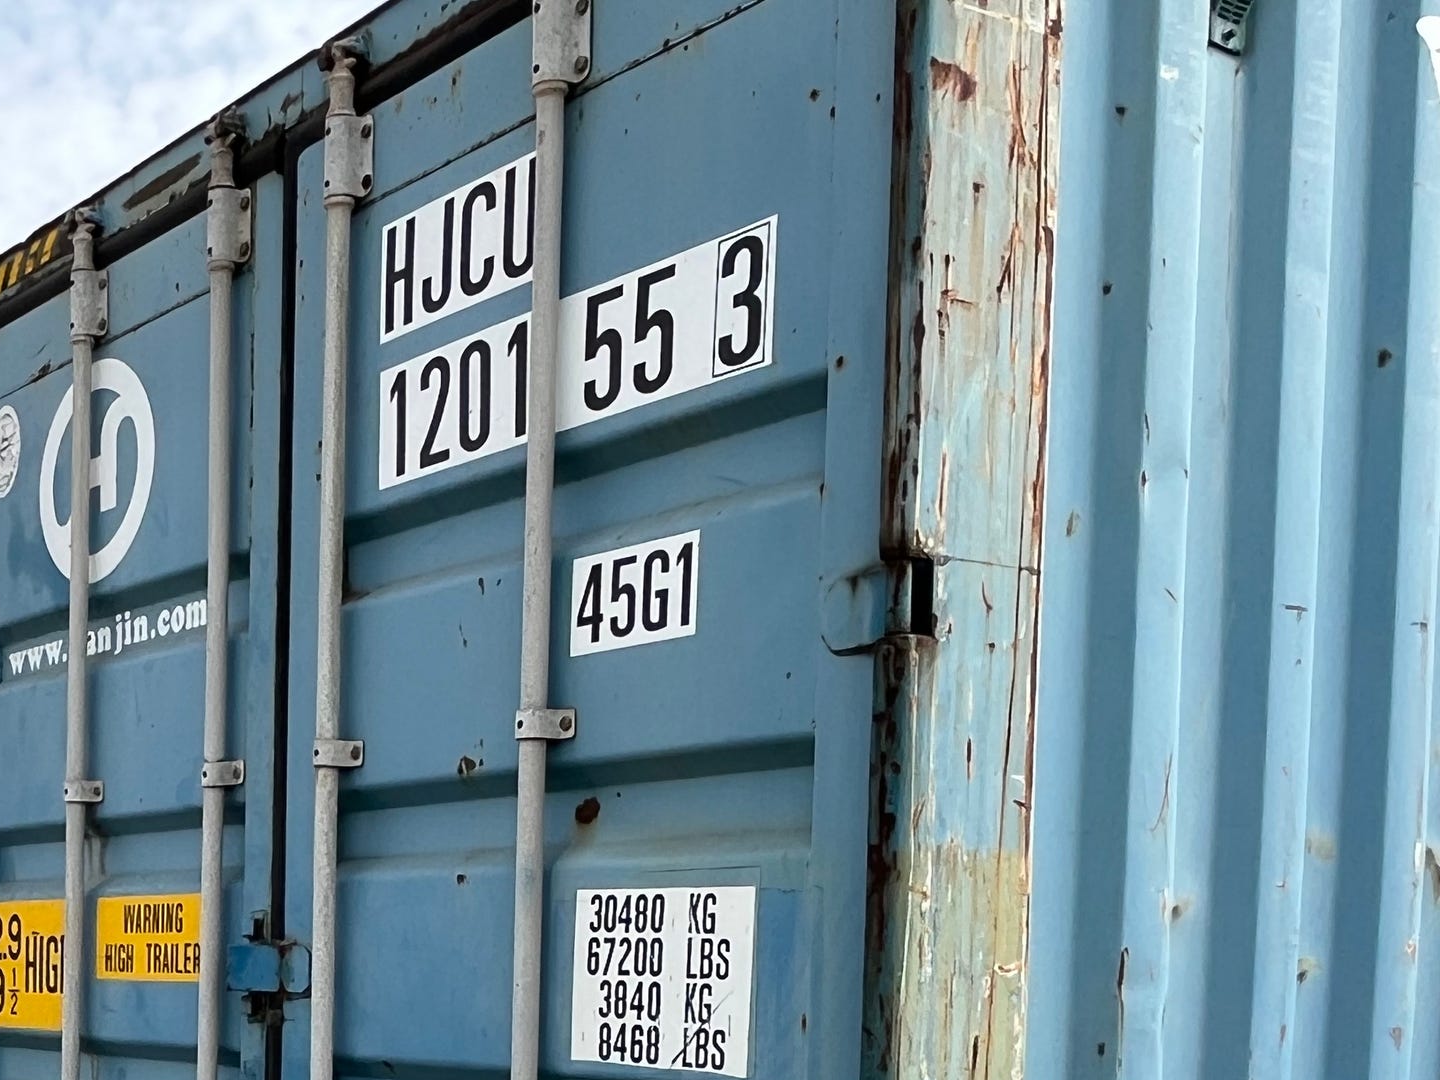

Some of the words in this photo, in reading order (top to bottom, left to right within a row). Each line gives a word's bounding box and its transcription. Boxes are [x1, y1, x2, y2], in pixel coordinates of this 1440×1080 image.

[385, 157, 536, 334] HJCU
[717, 234, 765, 368] 3
[576, 541, 693, 643] 45G1
[9, 599, 208, 676] www.anjin.com
[123, 903, 184, 934] WARNING
[589, 893, 665, 933] 30480
[688, 893, 717, 934] KG
[104, 943, 134, 973] HIGH
[146, 942, 201, 974] TRAILER
[587, 937, 664, 977] 67200
[686, 937, 731, 980] LBS
[598, 980, 661, 1021] 3840
[684, 982, 713, 1023] KG
[598, 1022, 660, 1064] 8468
[682, 1027, 726, 1070] LBS
